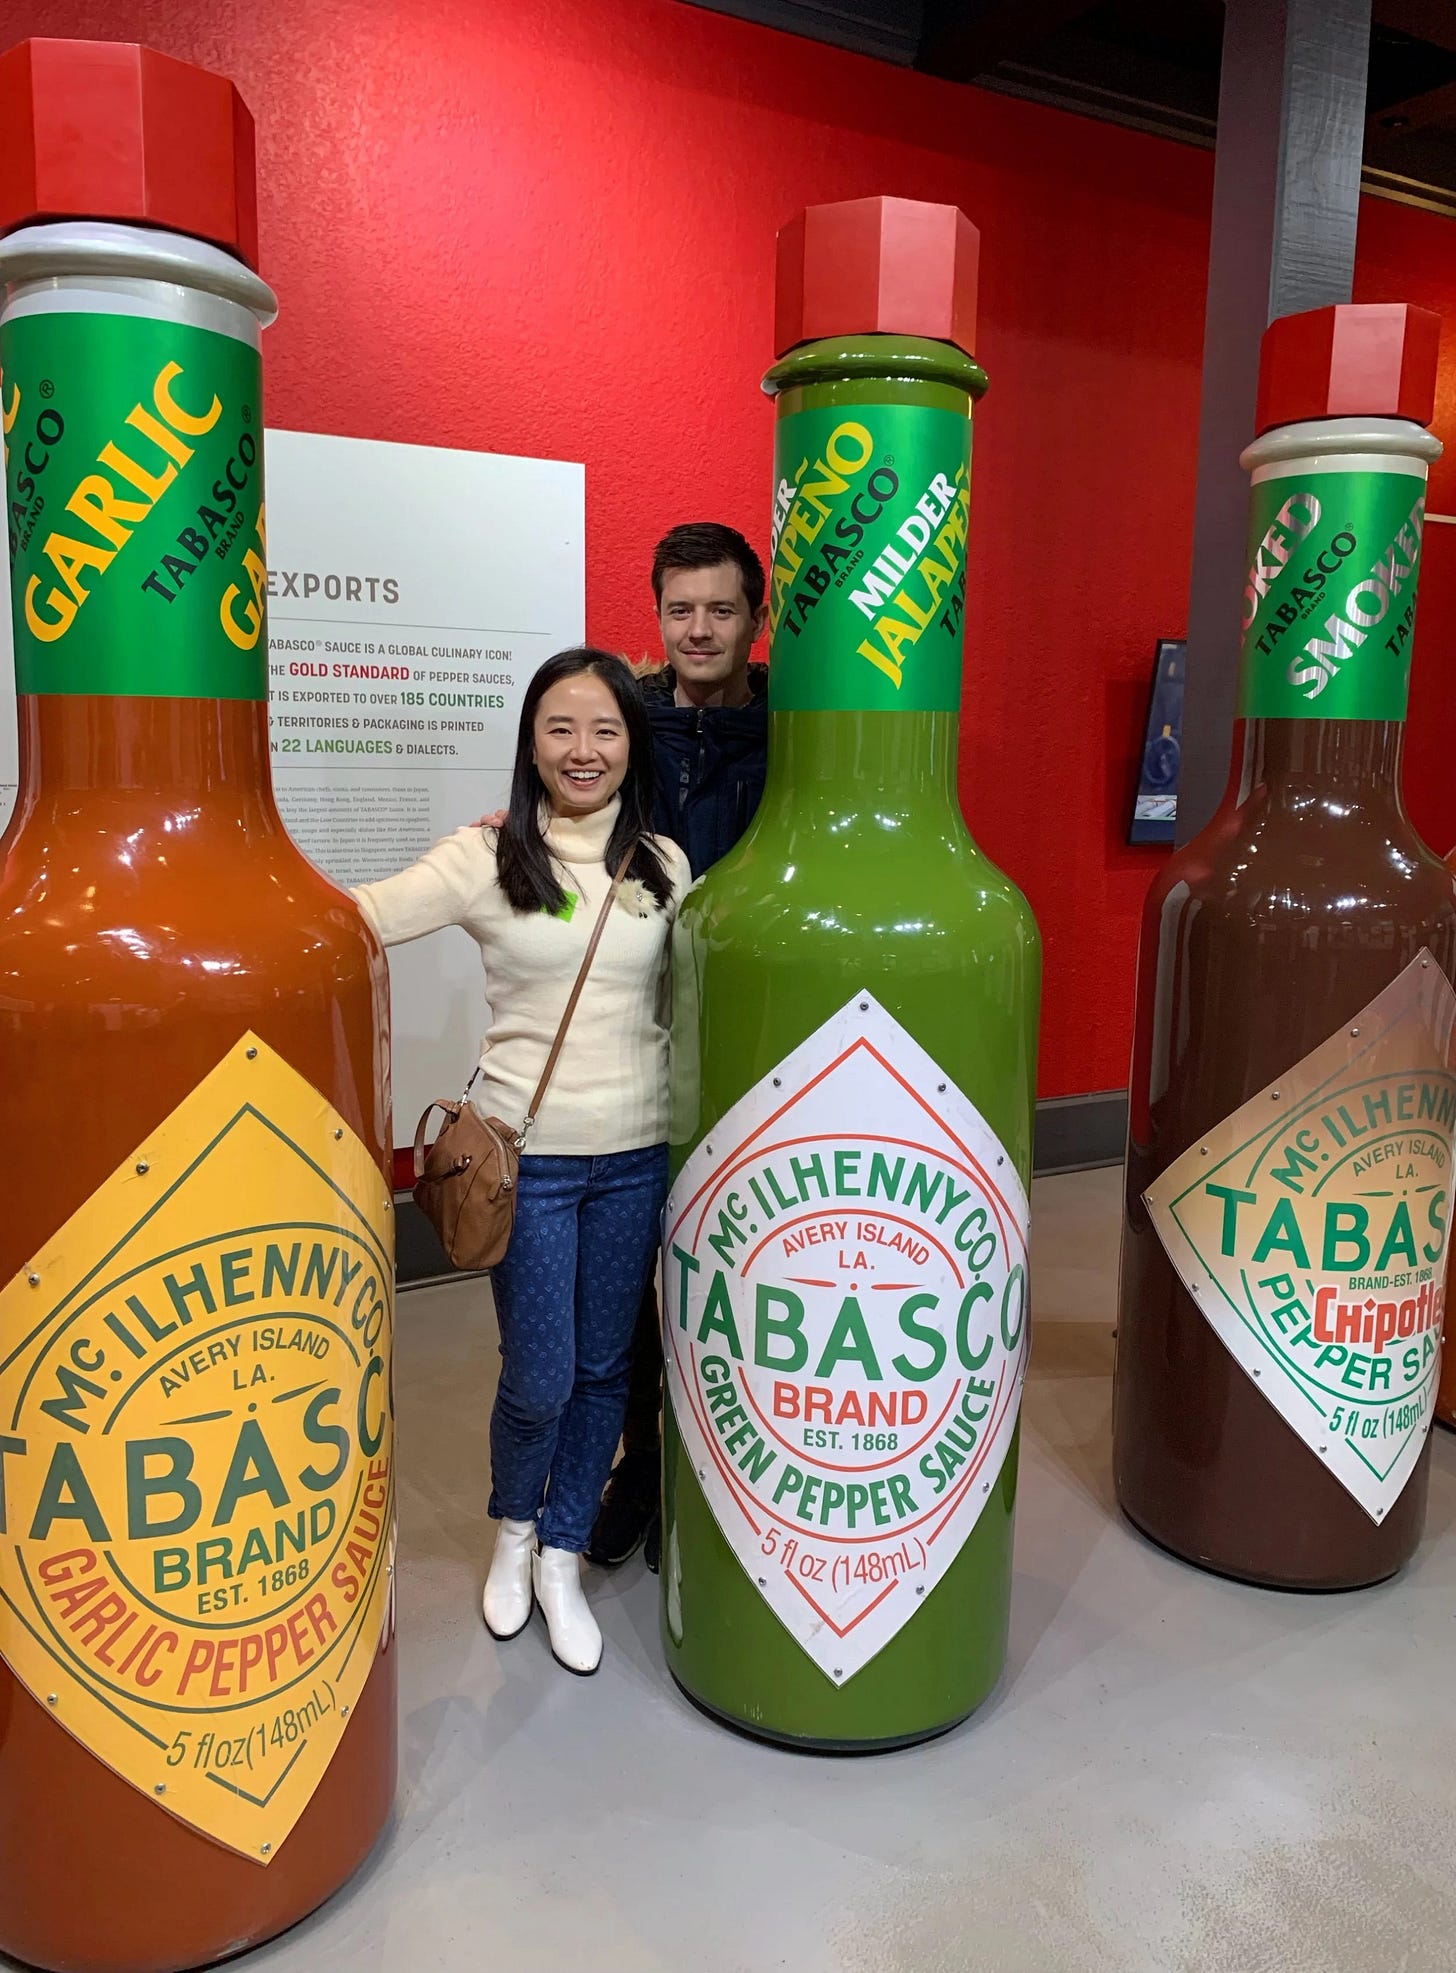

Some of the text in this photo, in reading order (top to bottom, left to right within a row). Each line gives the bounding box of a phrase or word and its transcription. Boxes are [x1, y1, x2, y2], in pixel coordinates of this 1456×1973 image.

[25, 361, 223, 642] GARLIC
[20, 496, 45, 552] BRAND
[214, 511, 245, 561] BRAND
[847, 472, 957, 622] MILDER
[835, 549, 865, 588] BRAND
[325, 641, 361, 653] SAUCE
[364, 643, 375, 654] IS
[378, 644, 386, 655] A
[388, 644, 429, 657] GLOBAL
[431, 646, 483, 659] CULINARY
[485, 650, 513, 661] ICON!
[268, 662, 515, 686] HE GOLD STANDARD OF PEPPER SAUCES,
[278, 691, 290, 702] IS
[292, 691, 350, 703] EXPORTED
[353, 693, 367, 704] TO
[369, 693, 398, 705] OVER
[400, 691, 425, 706] 185
[428, 692, 505, 708] COUNTRIES
[277, 716, 349, 728] TERRITORIES
[351, 718, 360, 729] &
[363, 718, 425, 730] PACKAGING
[427, 720, 438, 730] IS
[440, 720, 484, 732] PRINTED
[281, 738, 302, 753] 22
[305, 738, 393, 754] LANGUAGES
[406, 744, 459, 756] DIALECTS.
[1353, 1139, 1446, 1177] AVERY ISLAND
[1395, 1163, 1419, 1179] LA.
[781, 1221, 931, 1266] AVERY ISLAND
[838, 1250, 876, 1271] LA.
[1415, 1267, 1433, 1284] 1868
[672, 1242, 1025, 1383] TABASCO
[158, 1327, 331, 1400] AVERY ISLAND
[233, 1363, 277, 1391] LA.
[773, 1380, 929, 1428] BRAND
[1328, 1406, 1345, 1432] 5
[1361, 1417, 1380, 1440] oz
[700, 1354, 996, 1529] GREEN PEPPER SAUCE
[802, 1427, 899, 1452] EST. 1868
[153, 1497, 338, 1594] BRAND
[761, 1526, 782, 1557] 5
[799, 1553, 826, 1583] oz
[831, 1536, 929, 1594] (148mL)
[37, 1456, 390, 1698] GARLIC PEPPER SAUCE
[197, 1558, 312, 1616] EST. 1868
[165, 1730, 193, 1768] 5
